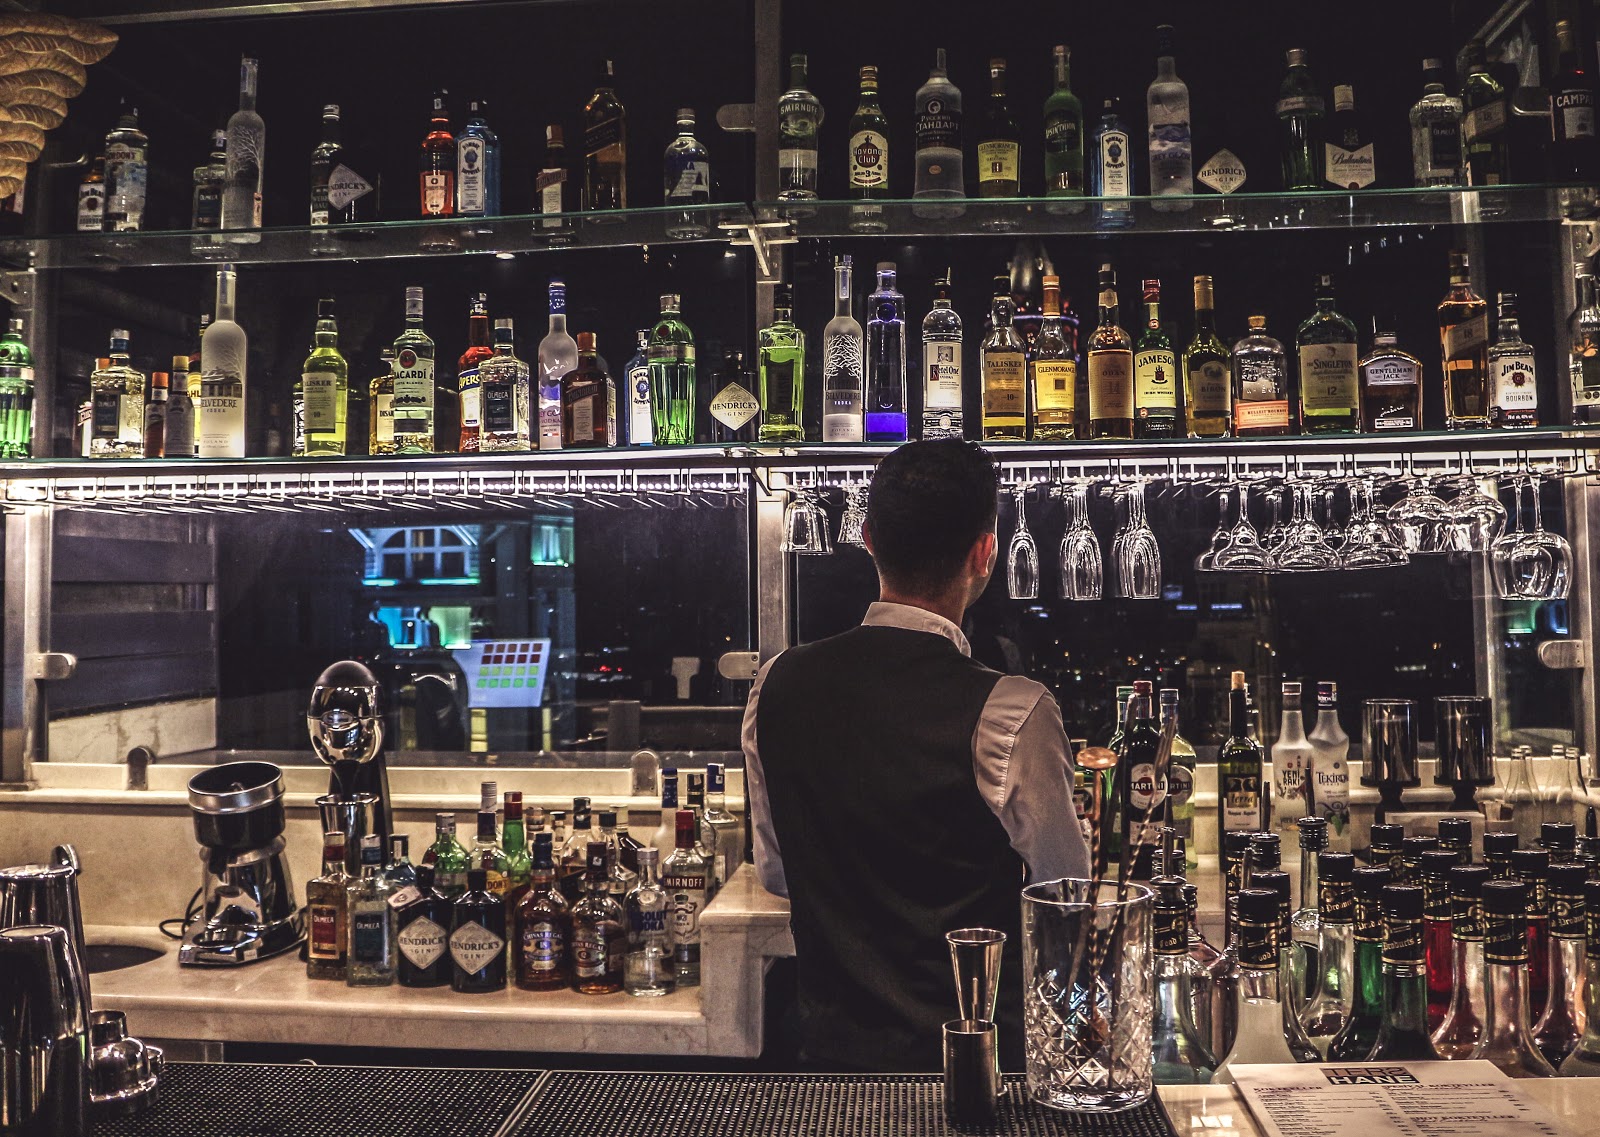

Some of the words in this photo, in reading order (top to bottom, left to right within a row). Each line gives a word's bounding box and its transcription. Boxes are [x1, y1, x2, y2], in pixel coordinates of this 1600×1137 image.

[1556, 94, 1593, 107] CAMPA
[780, 103, 818, 115] SMIRNOFF
[853, 147, 887, 156] Havana
[858, 155, 876, 164] Club
[1331, 152, 1372, 165] Ballantine's
[330, 182, 366, 191] NDRICK'S
[987, 360, 1023, 368] TALISKER
[1138, 354, 1175, 368] JAMESON
[1313, 359, 1353, 370] SINGLETON
[1037, 365, 1075, 374] GLENMORANG
[1370, 366, 1413, 375] GENTLEMAN
[1501, 364, 1515, 377] JIM
[1515, 360, 1534, 375] BEAM
[633, 371, 650, 380] BOMBA
[304, 379, 332, 387] LISKER
[825, 390, 861, 400] BELVEDERE
[1327, 386, 1337, 395] 12
[633, 397, 651, 405] SAPPHIR
[1006, 393, 1015, 401] 10
[1505, 394, 1534, 403] BOURBON
[711, 401, 758, 411] HENDRICK'S
[1283, 777, 1300, 786] RAKI
[1315, 770, 1349, 785] TEKİRD
[1130, 781, 1165, 790] MARTNI
[1169, 782, 1191, 791] RTINI
[313, 914, 335, 924] OLMECA
[356, 921, 381, 930] OLMECA
[399, 936, 444, 946] HENDRICK
[450, 940, 500, 952] HENDRICK'S
[1330, 1075, 1417, 1084] HANE
